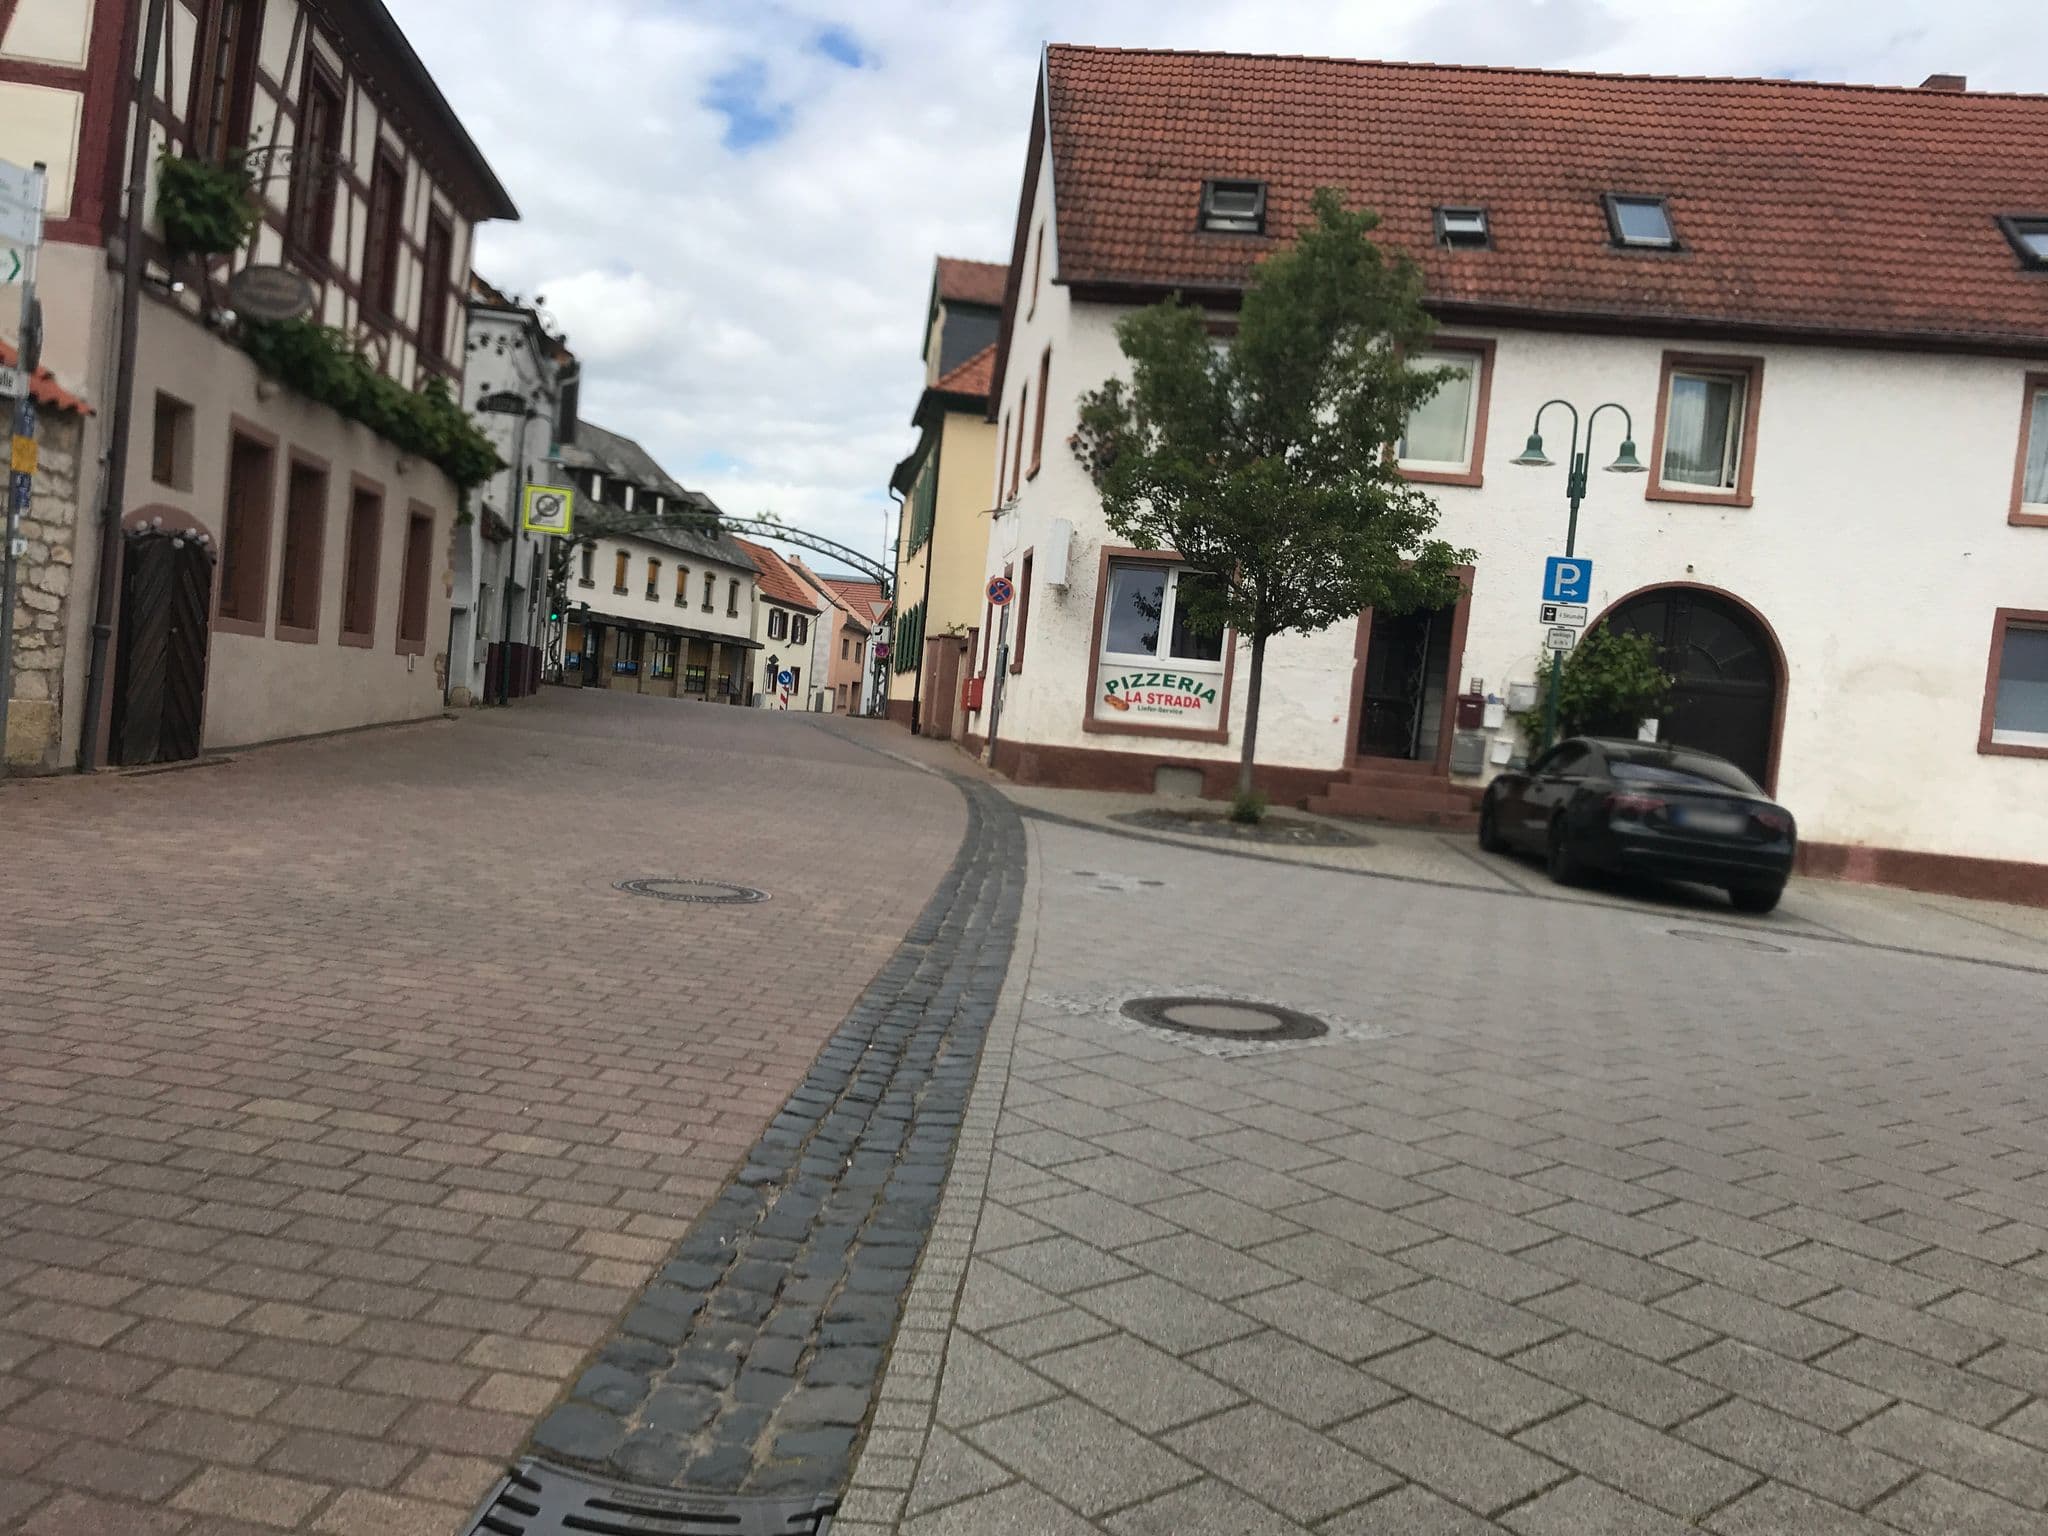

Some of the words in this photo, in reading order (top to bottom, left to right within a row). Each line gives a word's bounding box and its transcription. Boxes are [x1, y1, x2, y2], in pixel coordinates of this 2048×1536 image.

[1554, 563, 1581, 596] P
[1105, 673, 1217, 704] PIZZERIA
[1125, 691, 1142, 703] LA
[1147, 693, 1201, 709] STRADA
